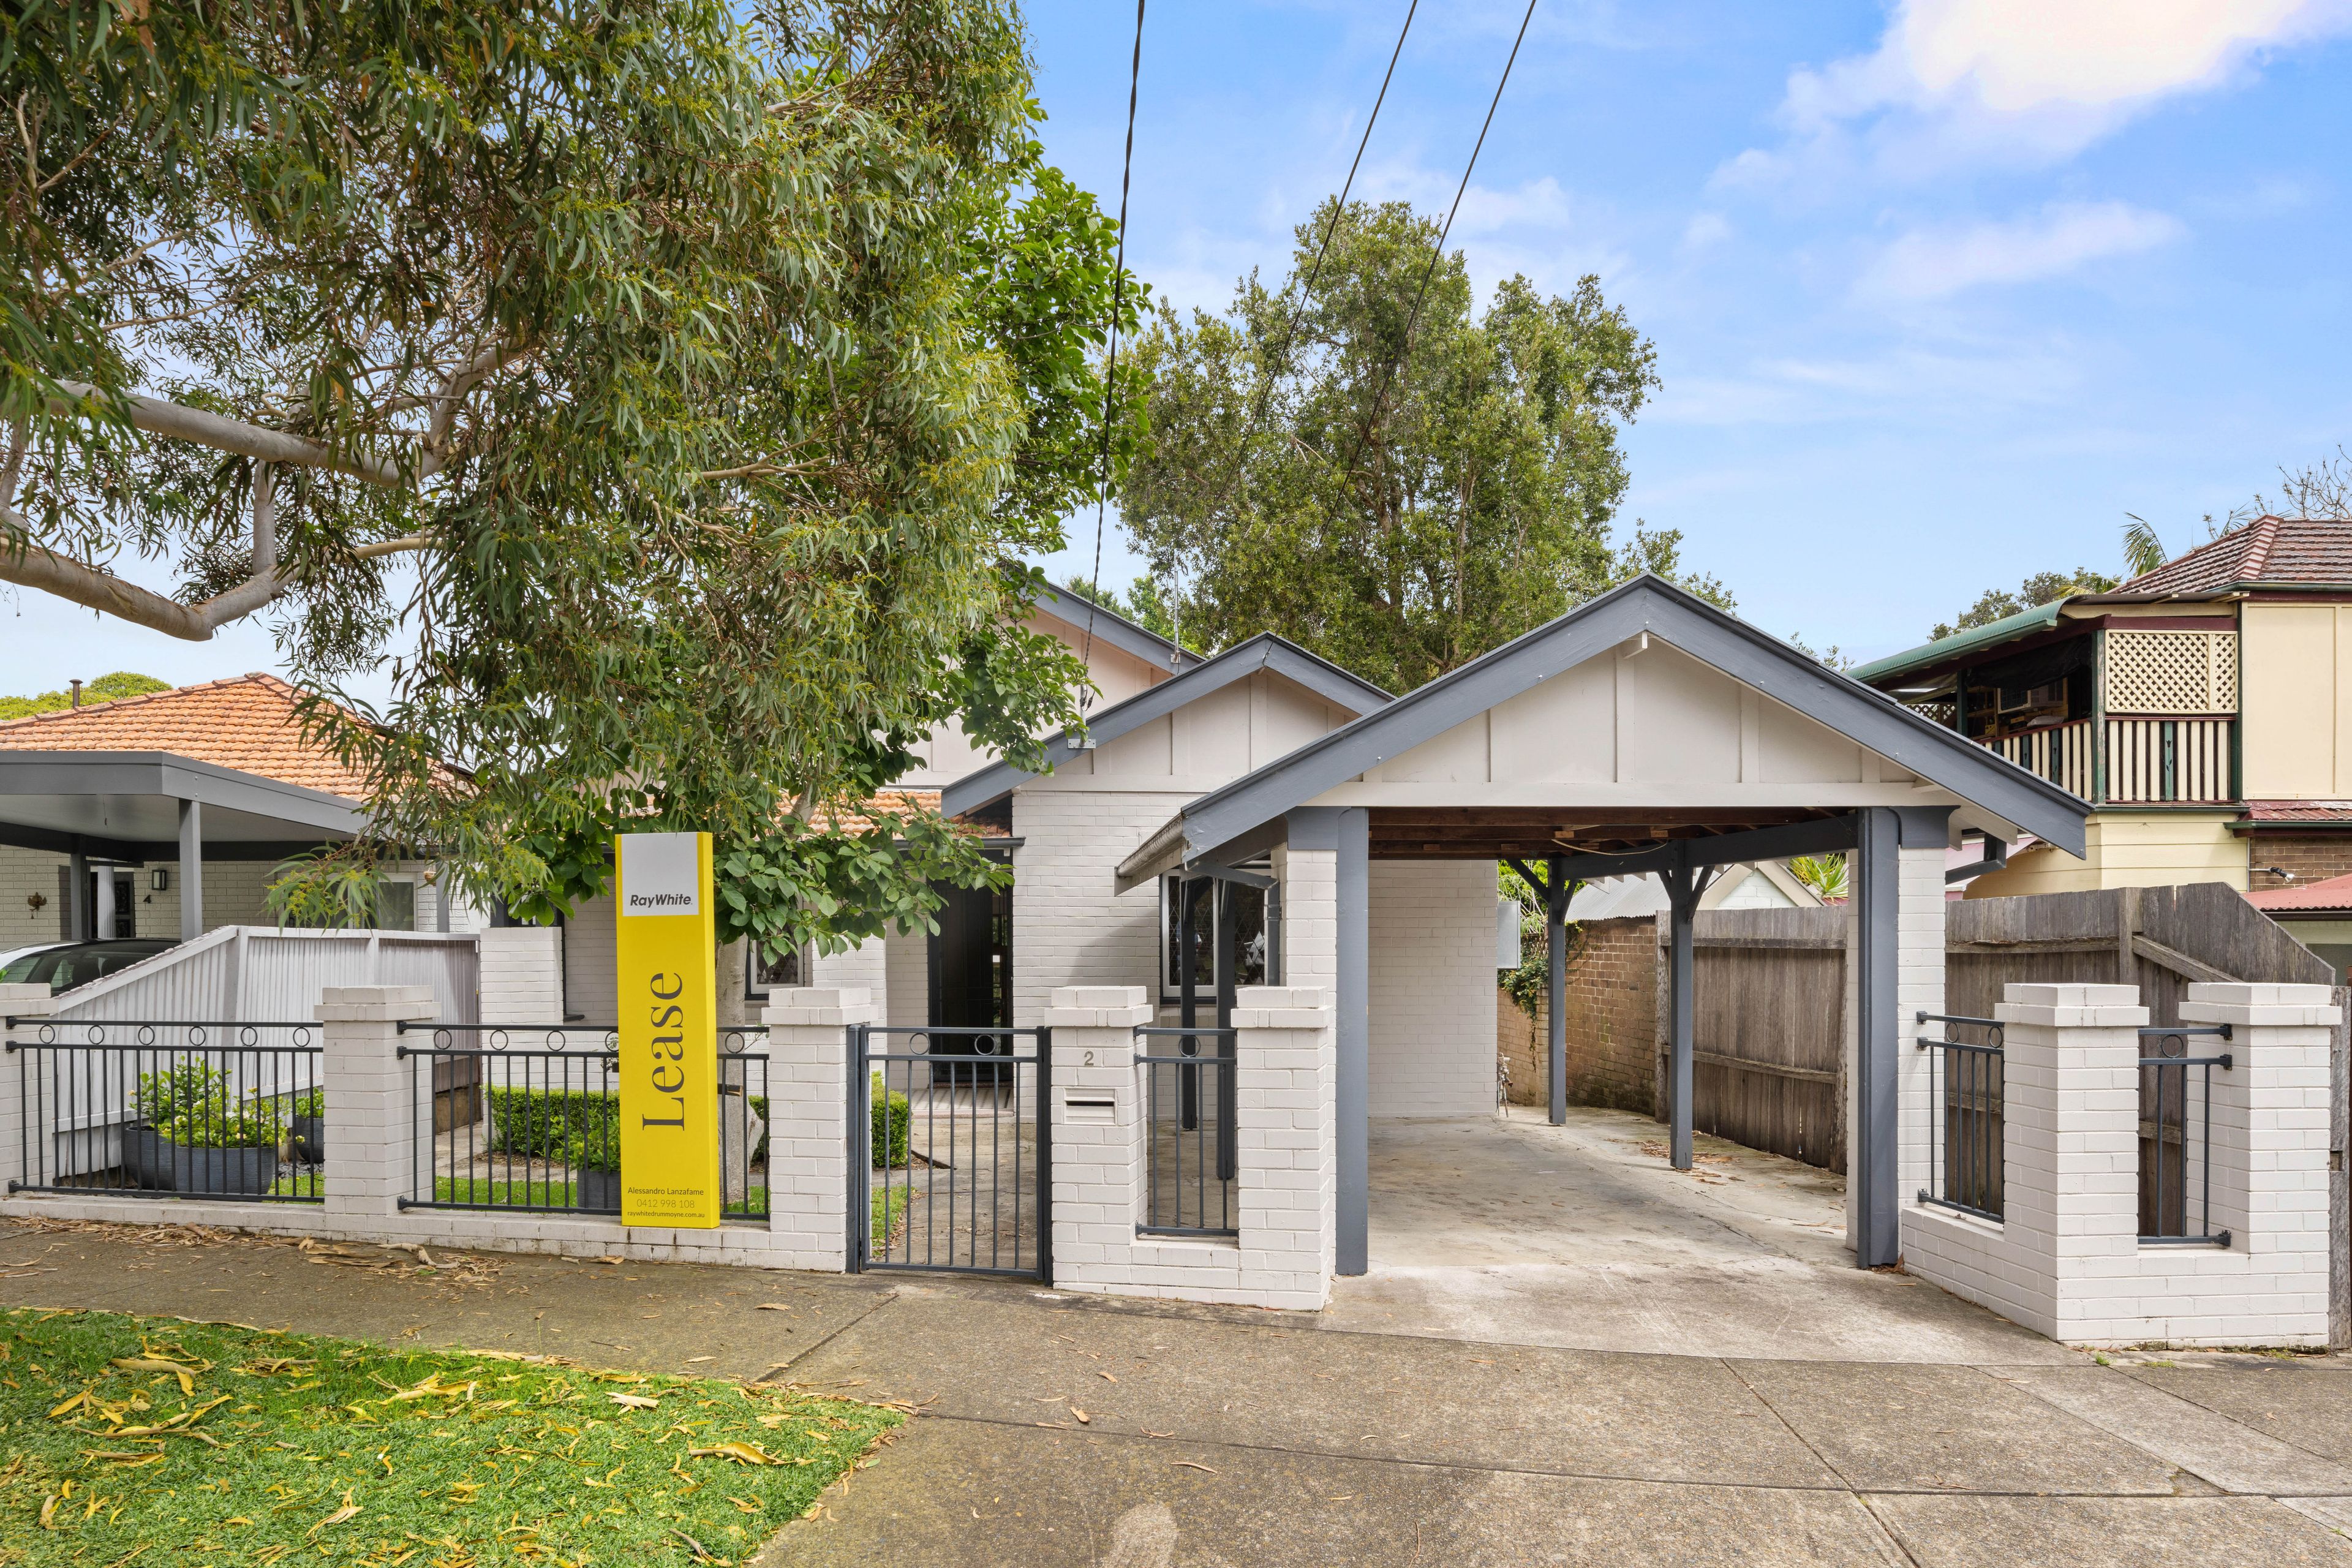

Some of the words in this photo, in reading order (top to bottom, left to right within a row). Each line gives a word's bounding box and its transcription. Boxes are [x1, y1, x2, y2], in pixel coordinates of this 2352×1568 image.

[143, 894, 152, 903] 4
[642, 973, 685, 1131] Lease
[1084, 1050, 1094, 1066] 2
[636, 1199, 657, 1207] 0412
[660, 1199, 676, 1208] 998
[679, 1200, 695, 1208] 108
